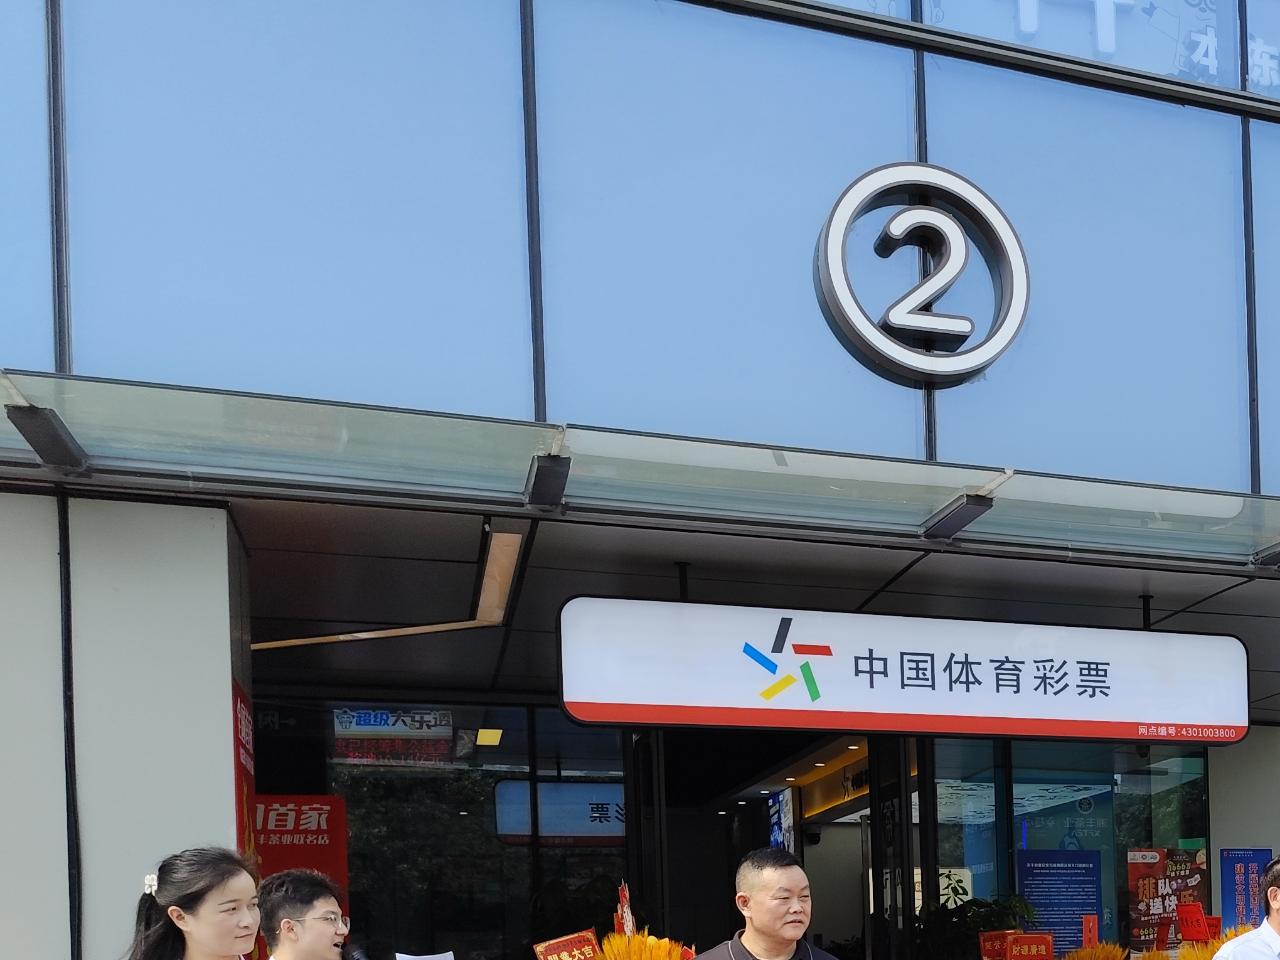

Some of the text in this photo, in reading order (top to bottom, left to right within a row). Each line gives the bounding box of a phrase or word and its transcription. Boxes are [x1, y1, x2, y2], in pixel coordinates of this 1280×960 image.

[876, 206, 976, 337] 2
[852, 648, 1112, 699] 中国体育彩票
[256, 803, 331, 831] 首家
